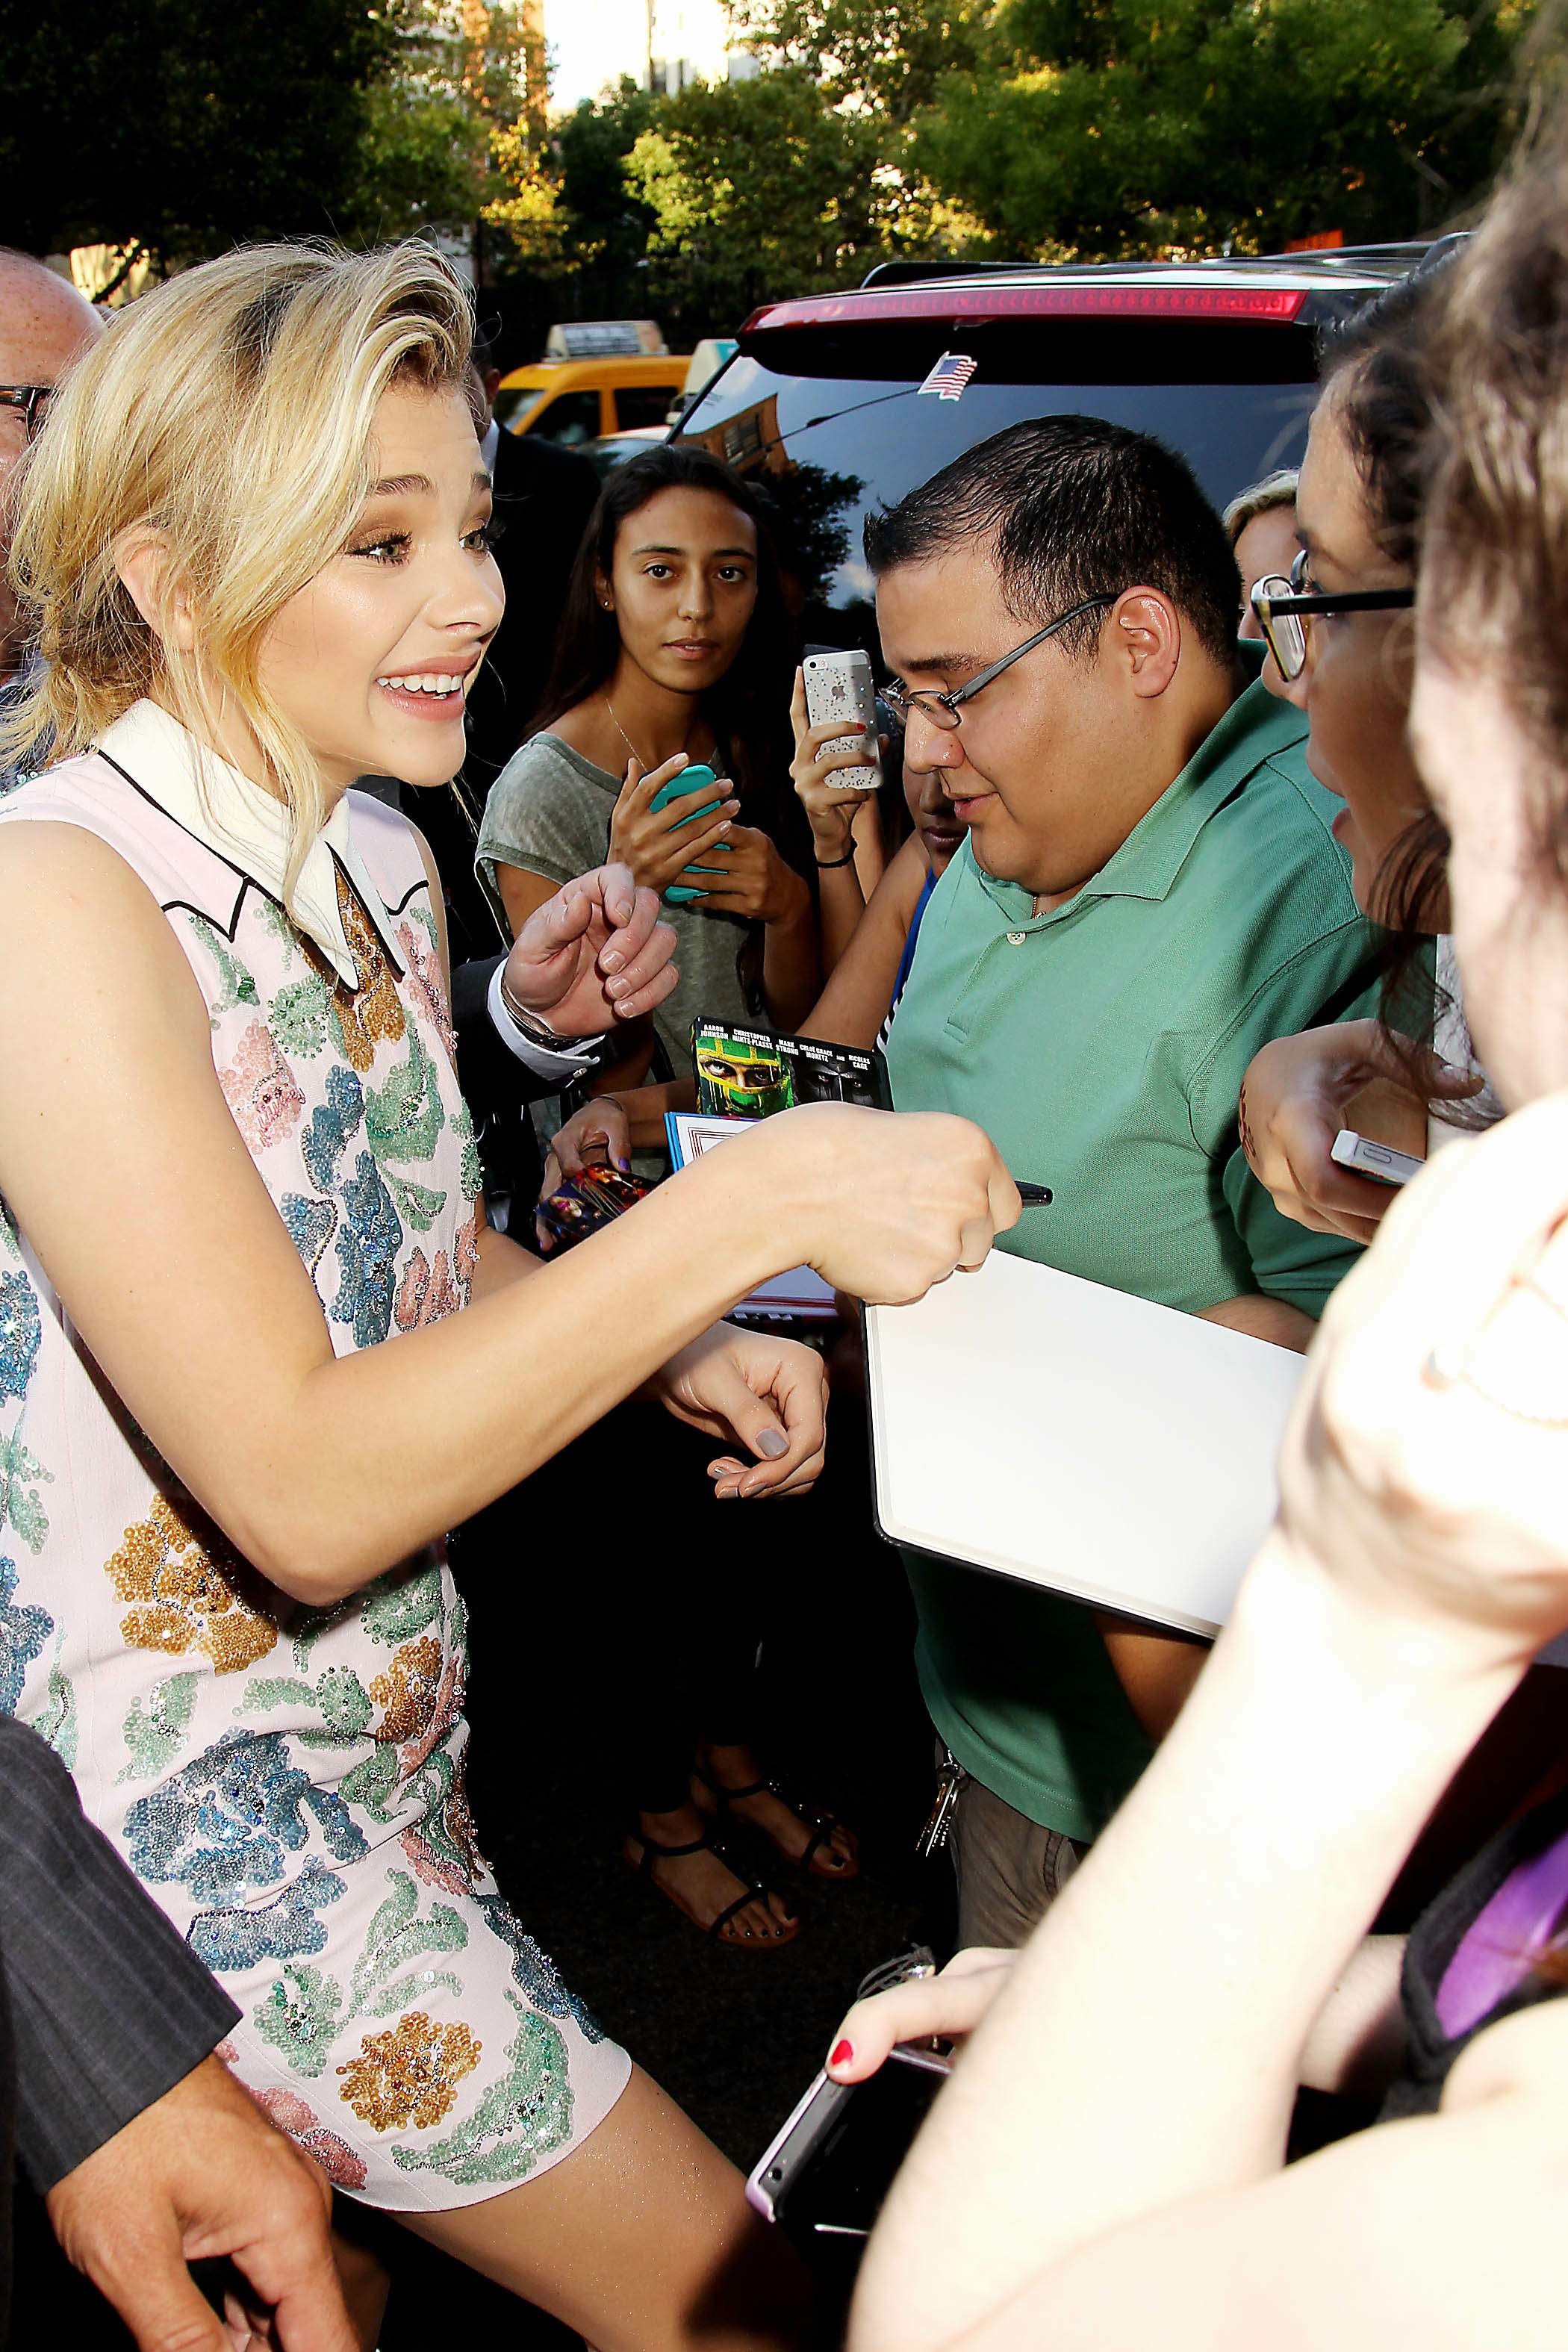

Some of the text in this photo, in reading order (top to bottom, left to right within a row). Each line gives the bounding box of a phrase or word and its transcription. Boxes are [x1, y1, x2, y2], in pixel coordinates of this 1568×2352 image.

[704, 1024, 724, 1033] AARON
[700, 1030, 729, 1040] JOHNSON
[733, 1029, 771, 1042] CHRISTOPHER
[732, 1035, 773, 1050] MINTZ-PLASSE
[778, 1039, 795, 1048] MARK
[776, 1045, 799, 1056] STRONG
[816, 1048, 833, 1057] GRACE
[806, 1051, 829, 1062] MORETZ
[848, 1055, 871, 1065] NICOLAS
[853, 1062, 868, 1070] CAGE
